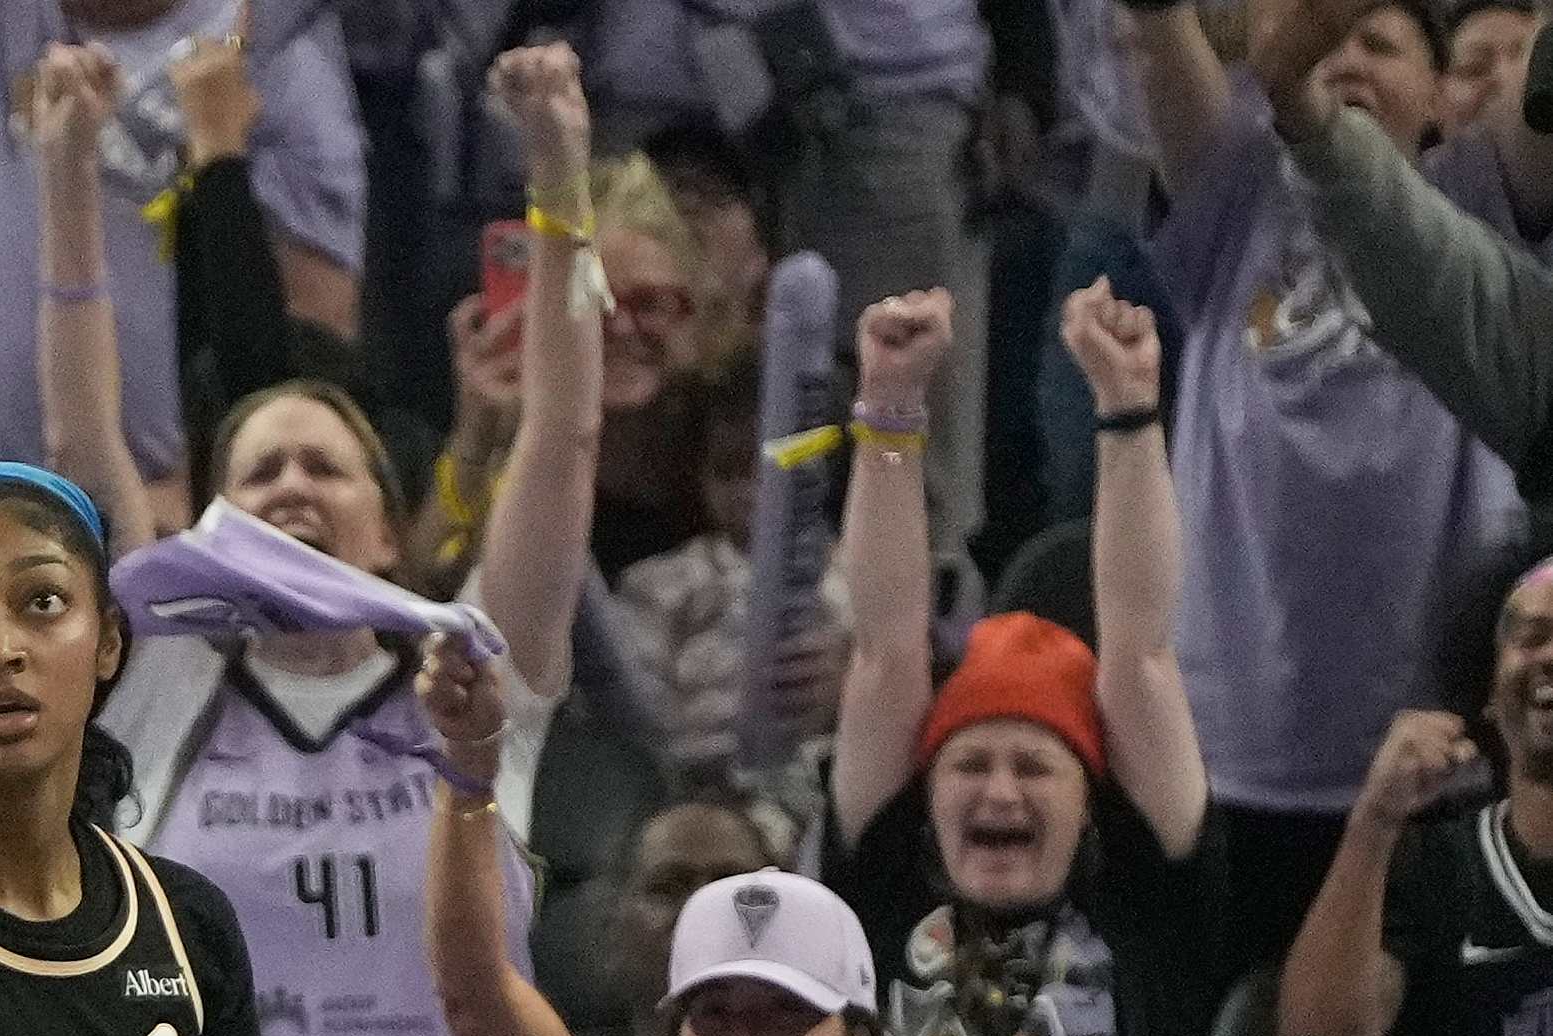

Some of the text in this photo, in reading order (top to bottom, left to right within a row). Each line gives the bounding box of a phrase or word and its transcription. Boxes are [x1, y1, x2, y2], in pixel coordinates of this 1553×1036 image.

[343, 771, 432, 823] STAT
[292, 852, 379, 939] 41
[125, 969, 189, 997] Albert
